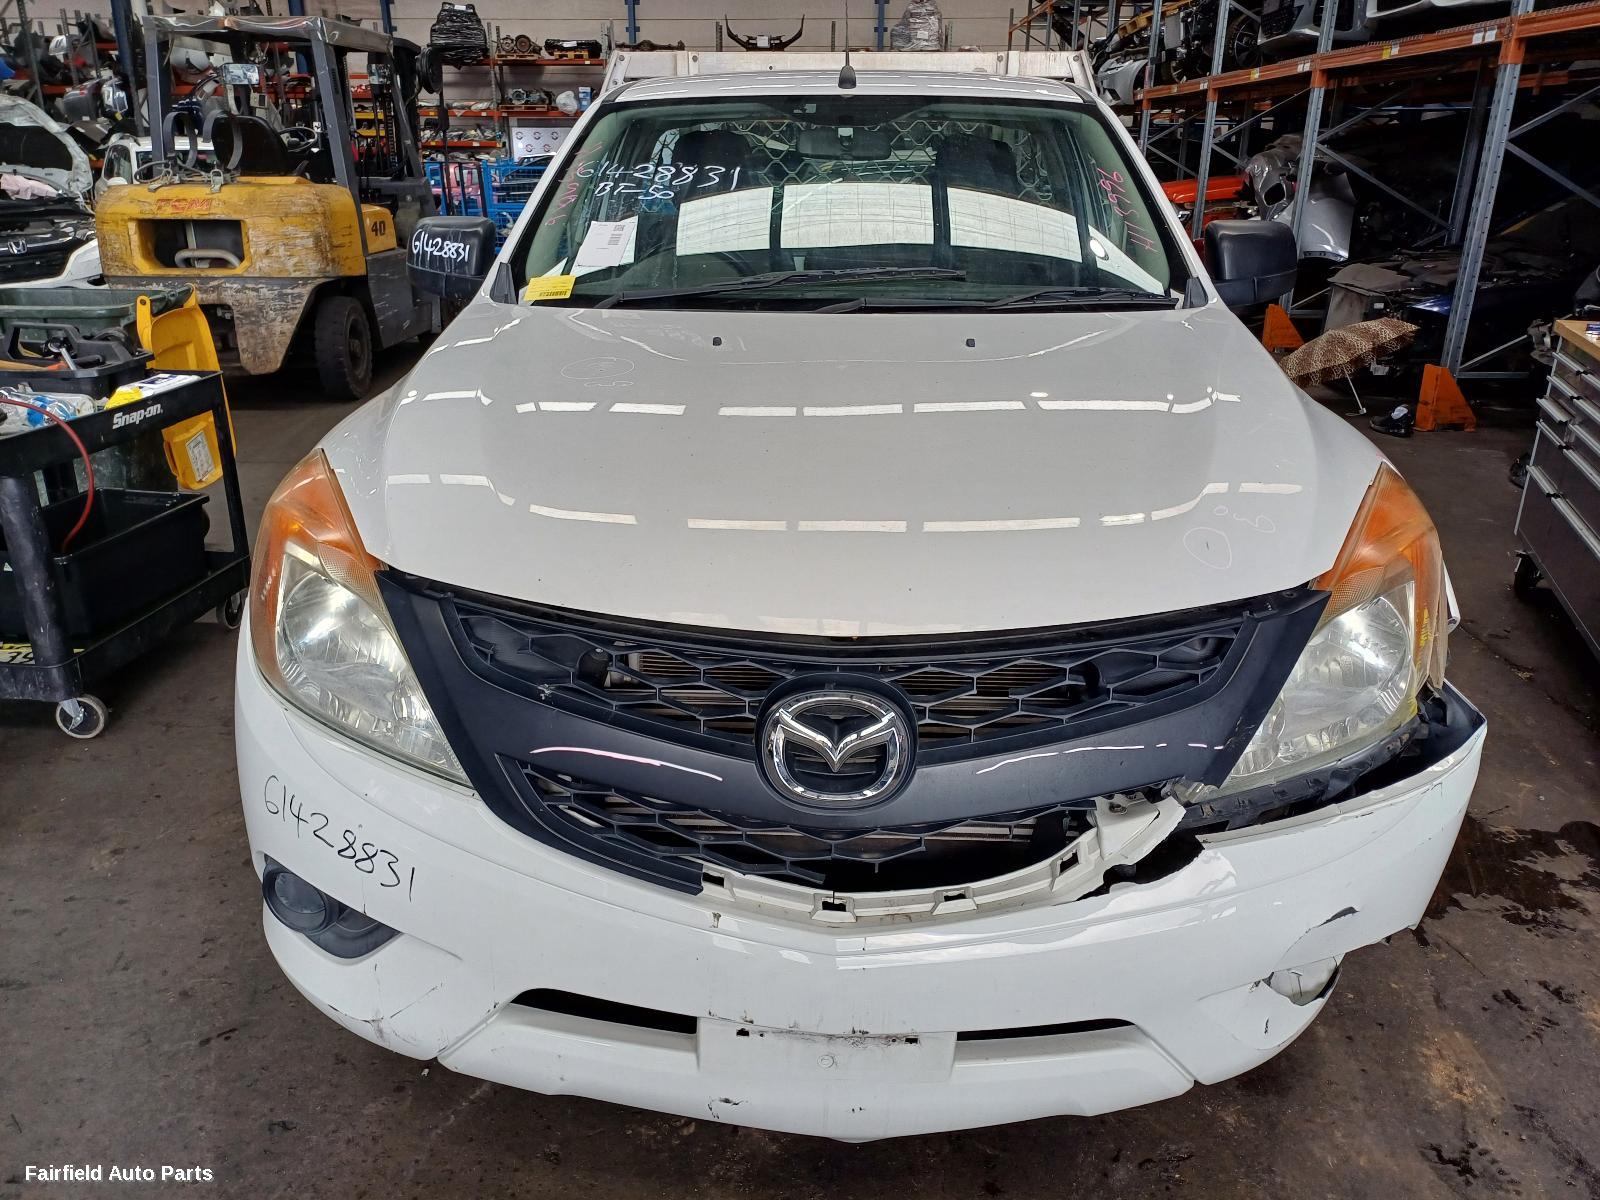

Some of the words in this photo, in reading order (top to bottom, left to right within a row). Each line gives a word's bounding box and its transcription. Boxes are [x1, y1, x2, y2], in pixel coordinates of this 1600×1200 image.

[575, 160, 741, 191] 61428831
[594, 182, 676, 199] BT-50
[371, 220, 386, 237] 40
[112, 403, 162, 430] Snap-on
[264, 774, 416, 903] 61428831
